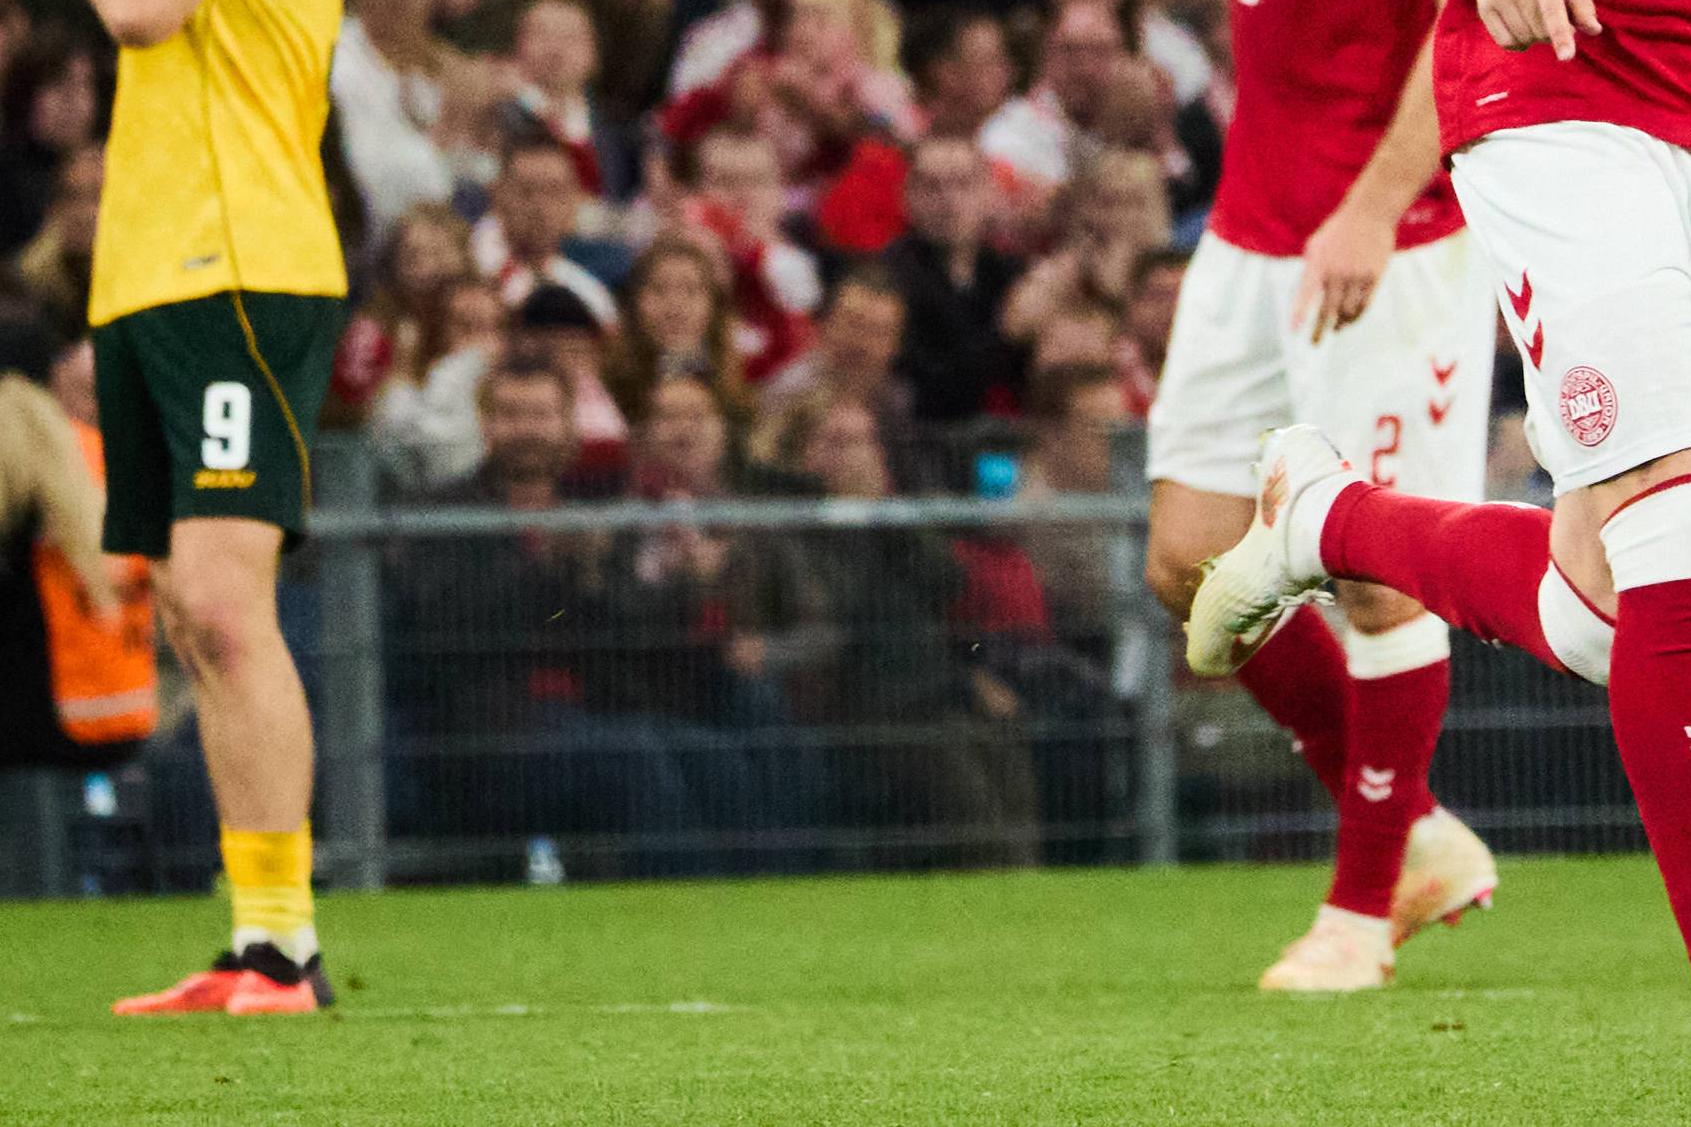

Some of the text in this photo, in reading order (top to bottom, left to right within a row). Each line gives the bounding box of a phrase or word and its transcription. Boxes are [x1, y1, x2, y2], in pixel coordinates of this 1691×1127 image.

[201, 381, 251, 471] 9
[1567, 390, 1602, 421] DBU
[1372, 415, 1401, 485] 2
